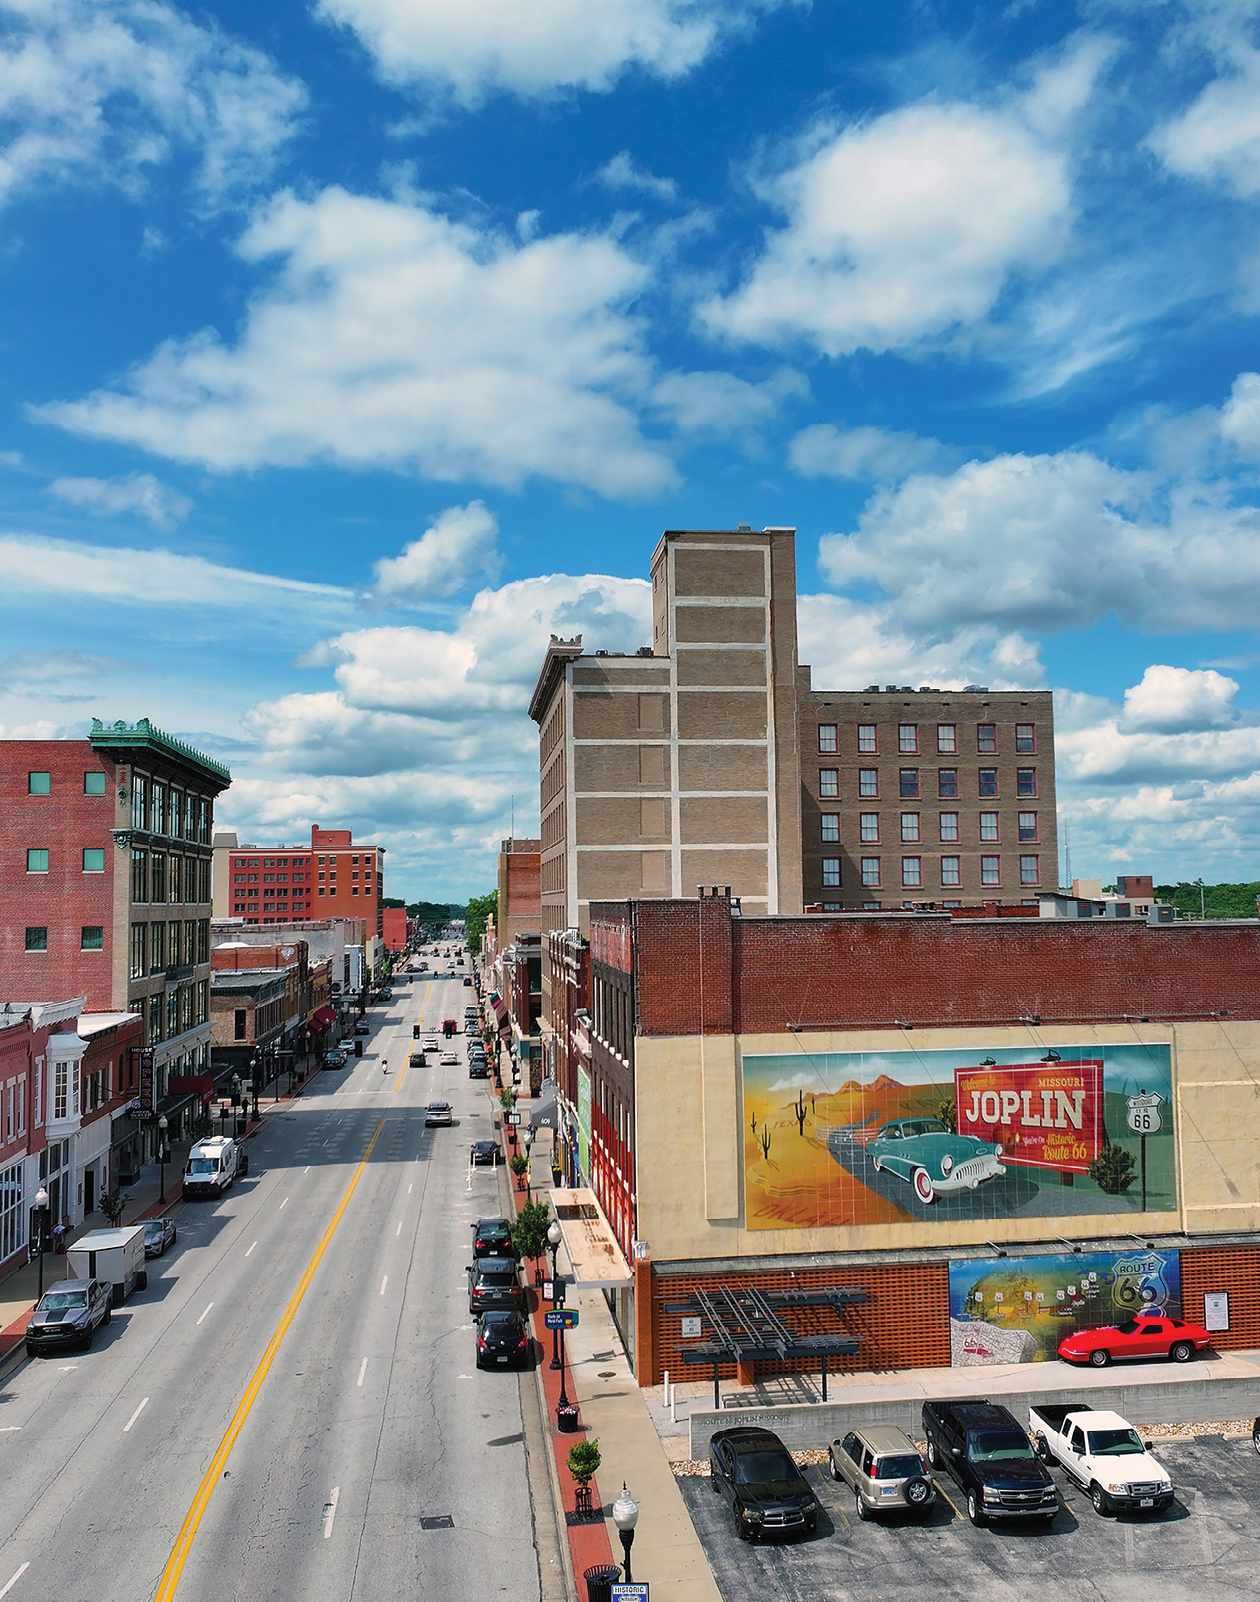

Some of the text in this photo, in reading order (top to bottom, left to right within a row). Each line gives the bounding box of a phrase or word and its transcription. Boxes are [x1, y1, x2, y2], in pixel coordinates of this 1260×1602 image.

[142, 1060, 152, 1108] SPEED
[960, 1075, 996, 1091] Welcome to
[1038, 1077, 1084, 1088] MISSOURI
[966, 1090, 1086, 1130] JOPLIN
[1134, 1114, 1150, 1129] 66
[1046, 1132, 1076, 1145] Historic
[1042, 1142, 1087, 1160] Route 66
[1120, 1262, 1155, 1273] ROUTE
[1120, 1276, 1158, 1302] 66
[701, 1418, 724, 1426] ROUTE
[734, 1416, 757, 1425] JOPLIN
